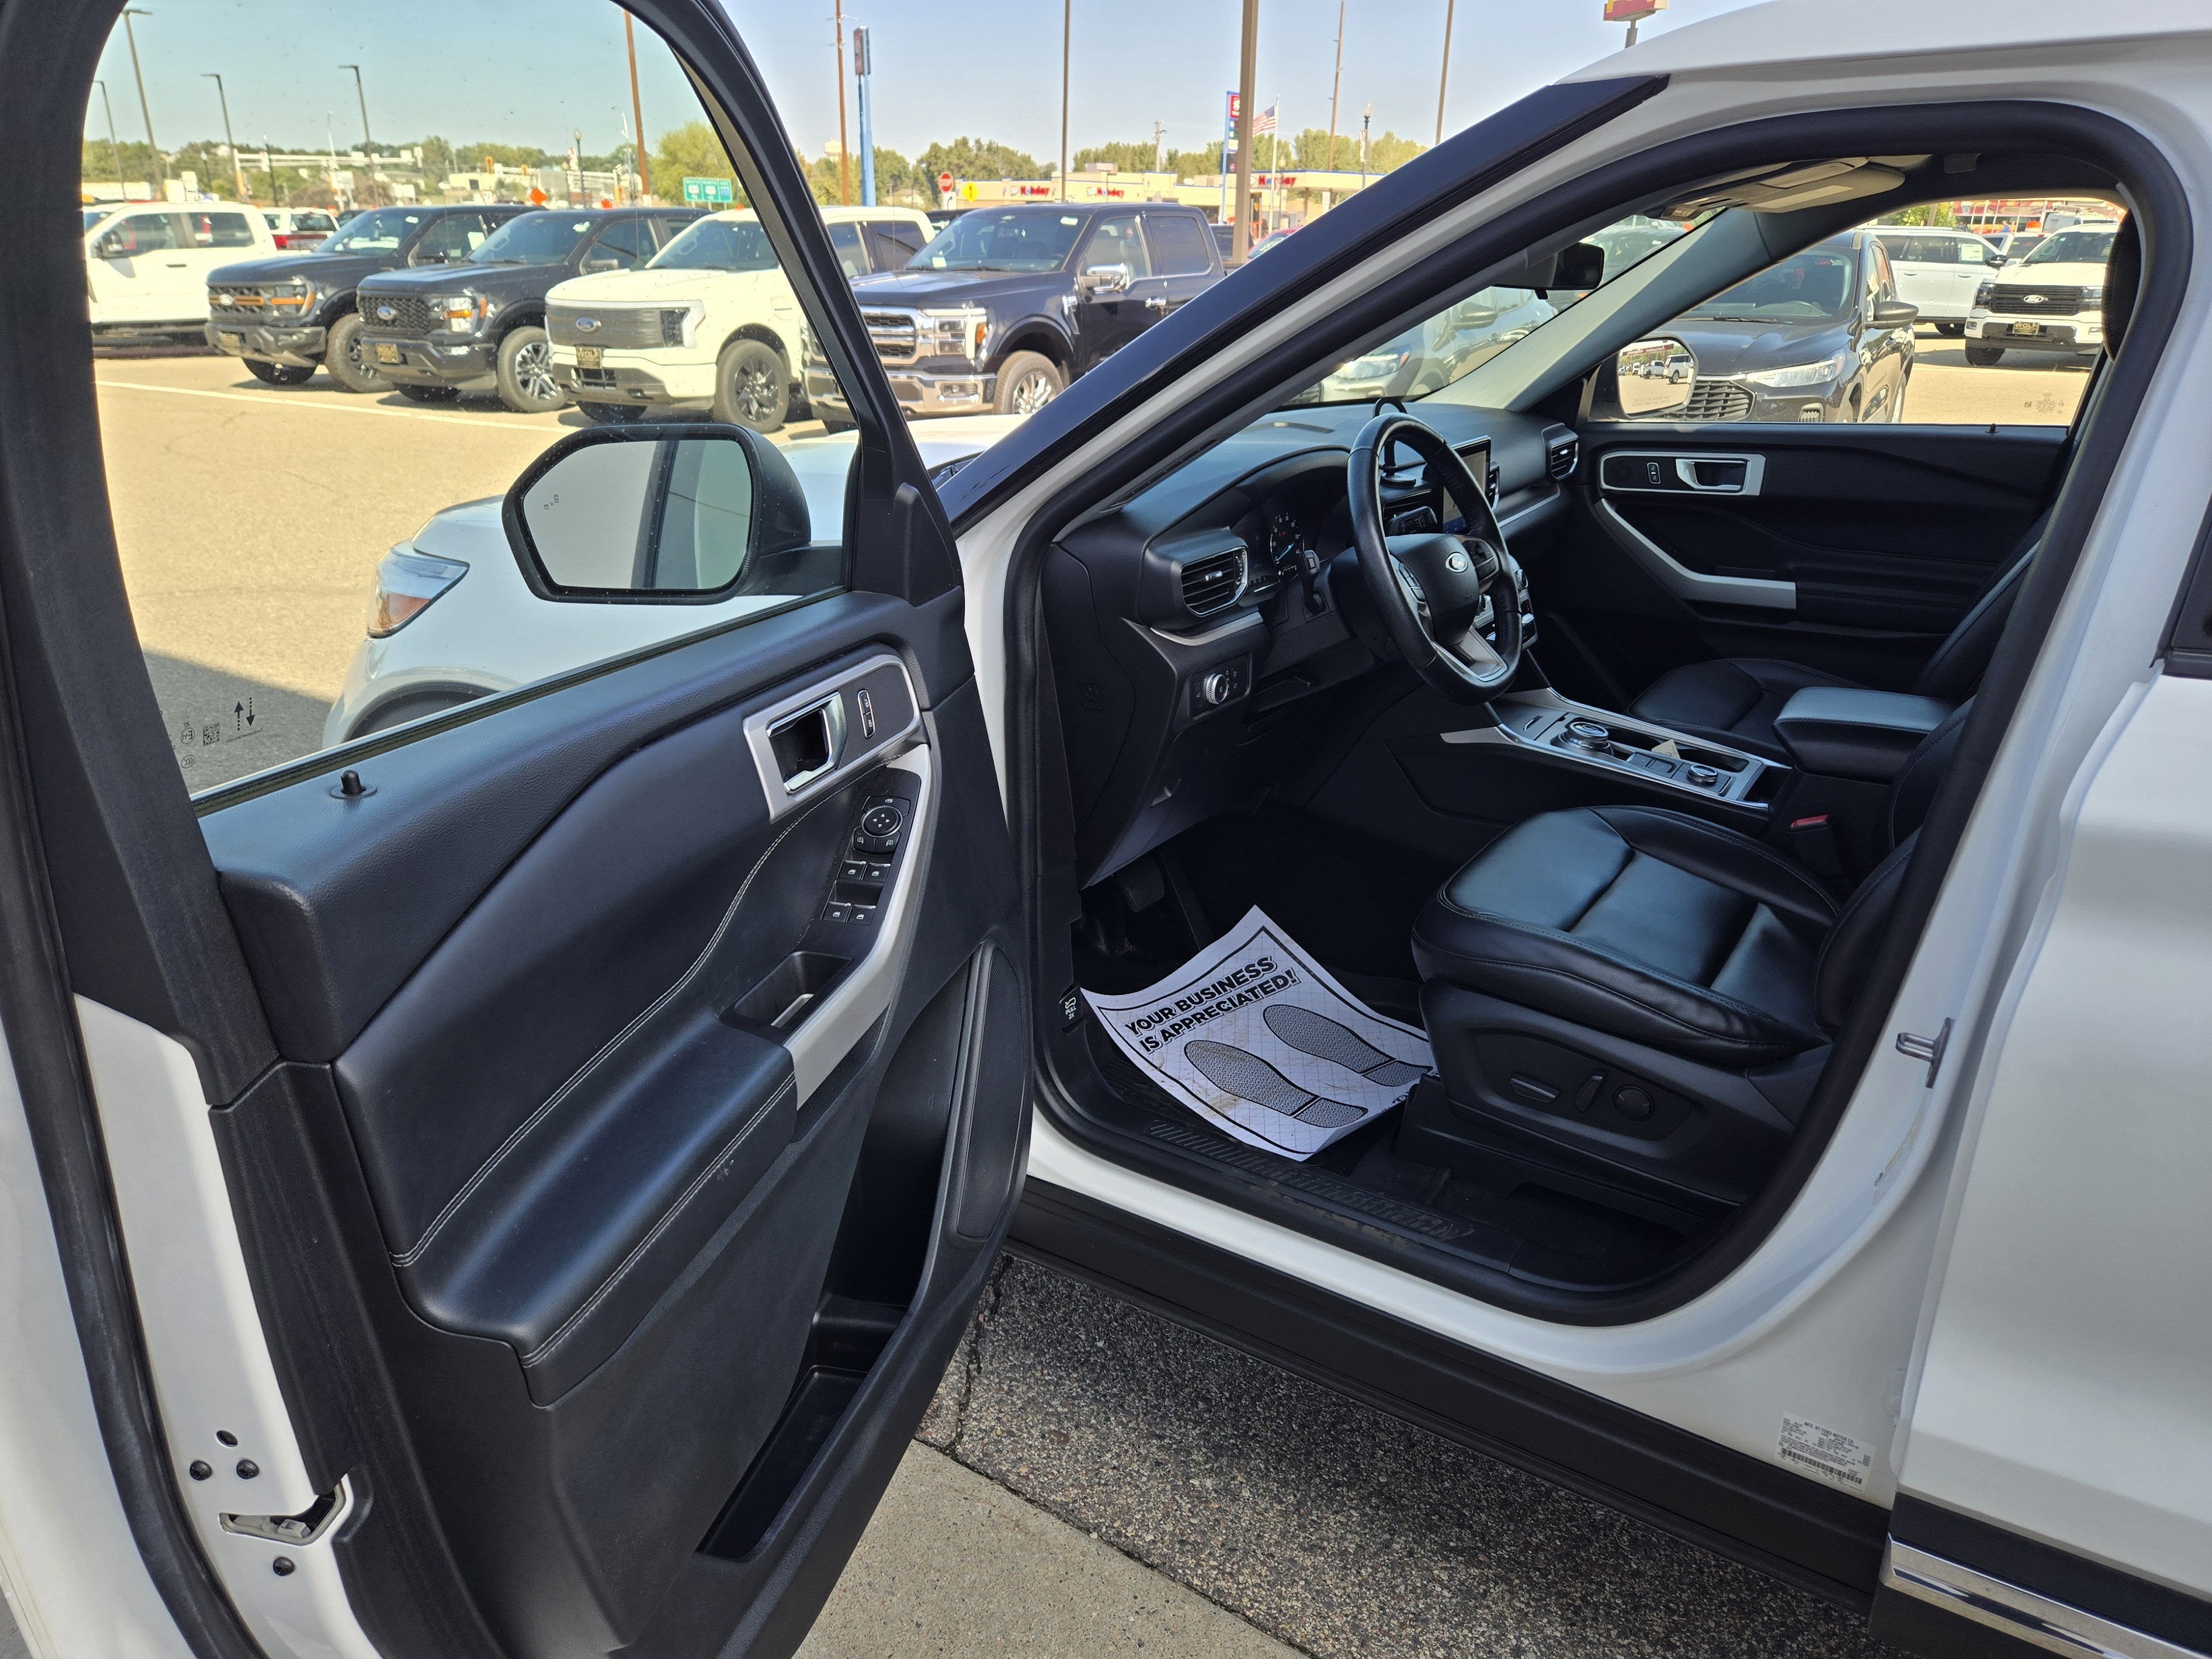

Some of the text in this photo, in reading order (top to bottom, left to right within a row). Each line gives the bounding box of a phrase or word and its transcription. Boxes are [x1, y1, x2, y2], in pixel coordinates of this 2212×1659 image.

[1065, 1005, 1077, 1015] PULL
[1125, 955, 1277, 1036] YOUR BUSINESS
[1138, 967, 1302, 1055] IS APPRECIATED!
[1833, 1432, 1847, 1442] MOTOR
